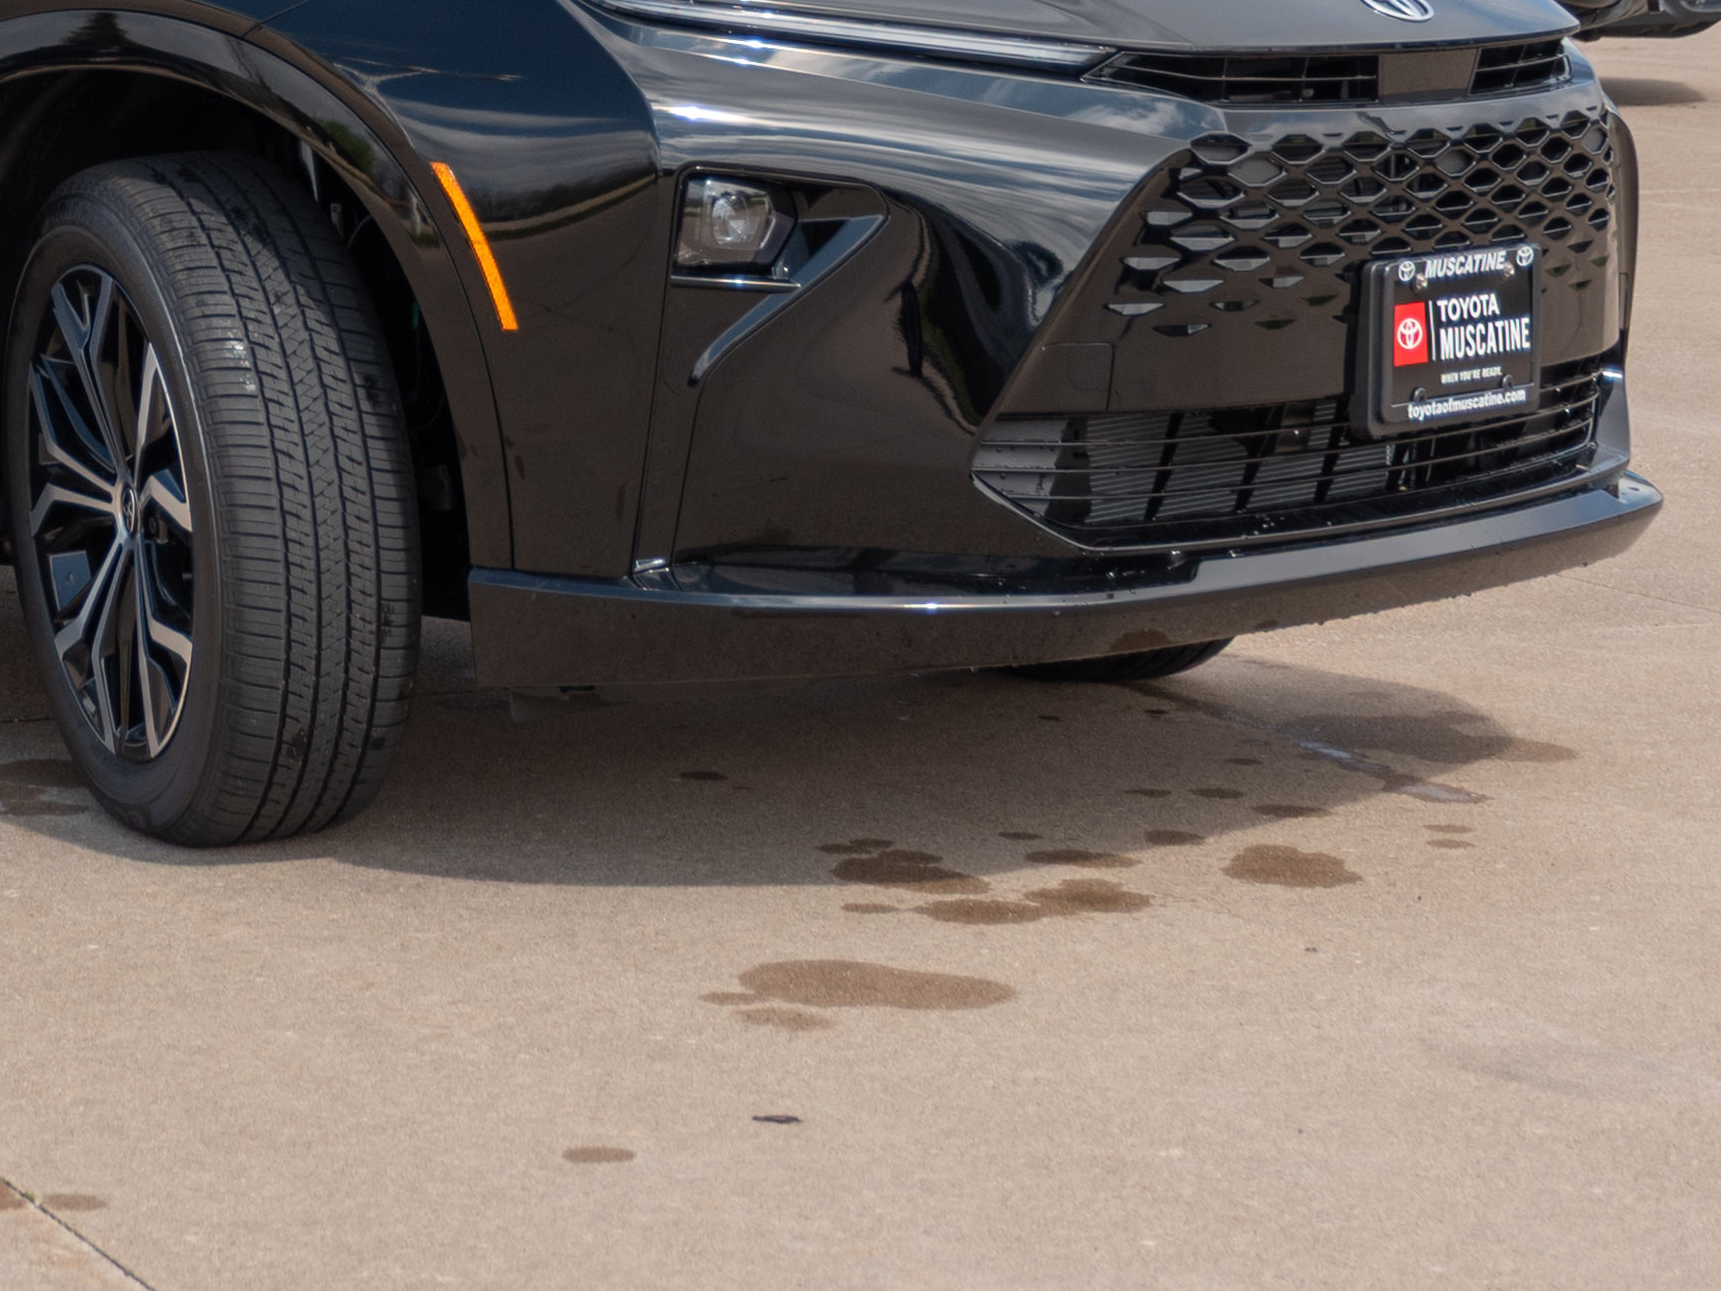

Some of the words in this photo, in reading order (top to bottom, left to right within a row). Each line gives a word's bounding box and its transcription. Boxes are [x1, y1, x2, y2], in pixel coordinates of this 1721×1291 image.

[1424, 250, 1507, 279] MUSCATINE
[1436, 293, 1500, 322] TOYOTA
[1439, 317, 1531, 360] MUSCATINE
[1407, 389, 1526, 421] toyotaofmuscatine.com
